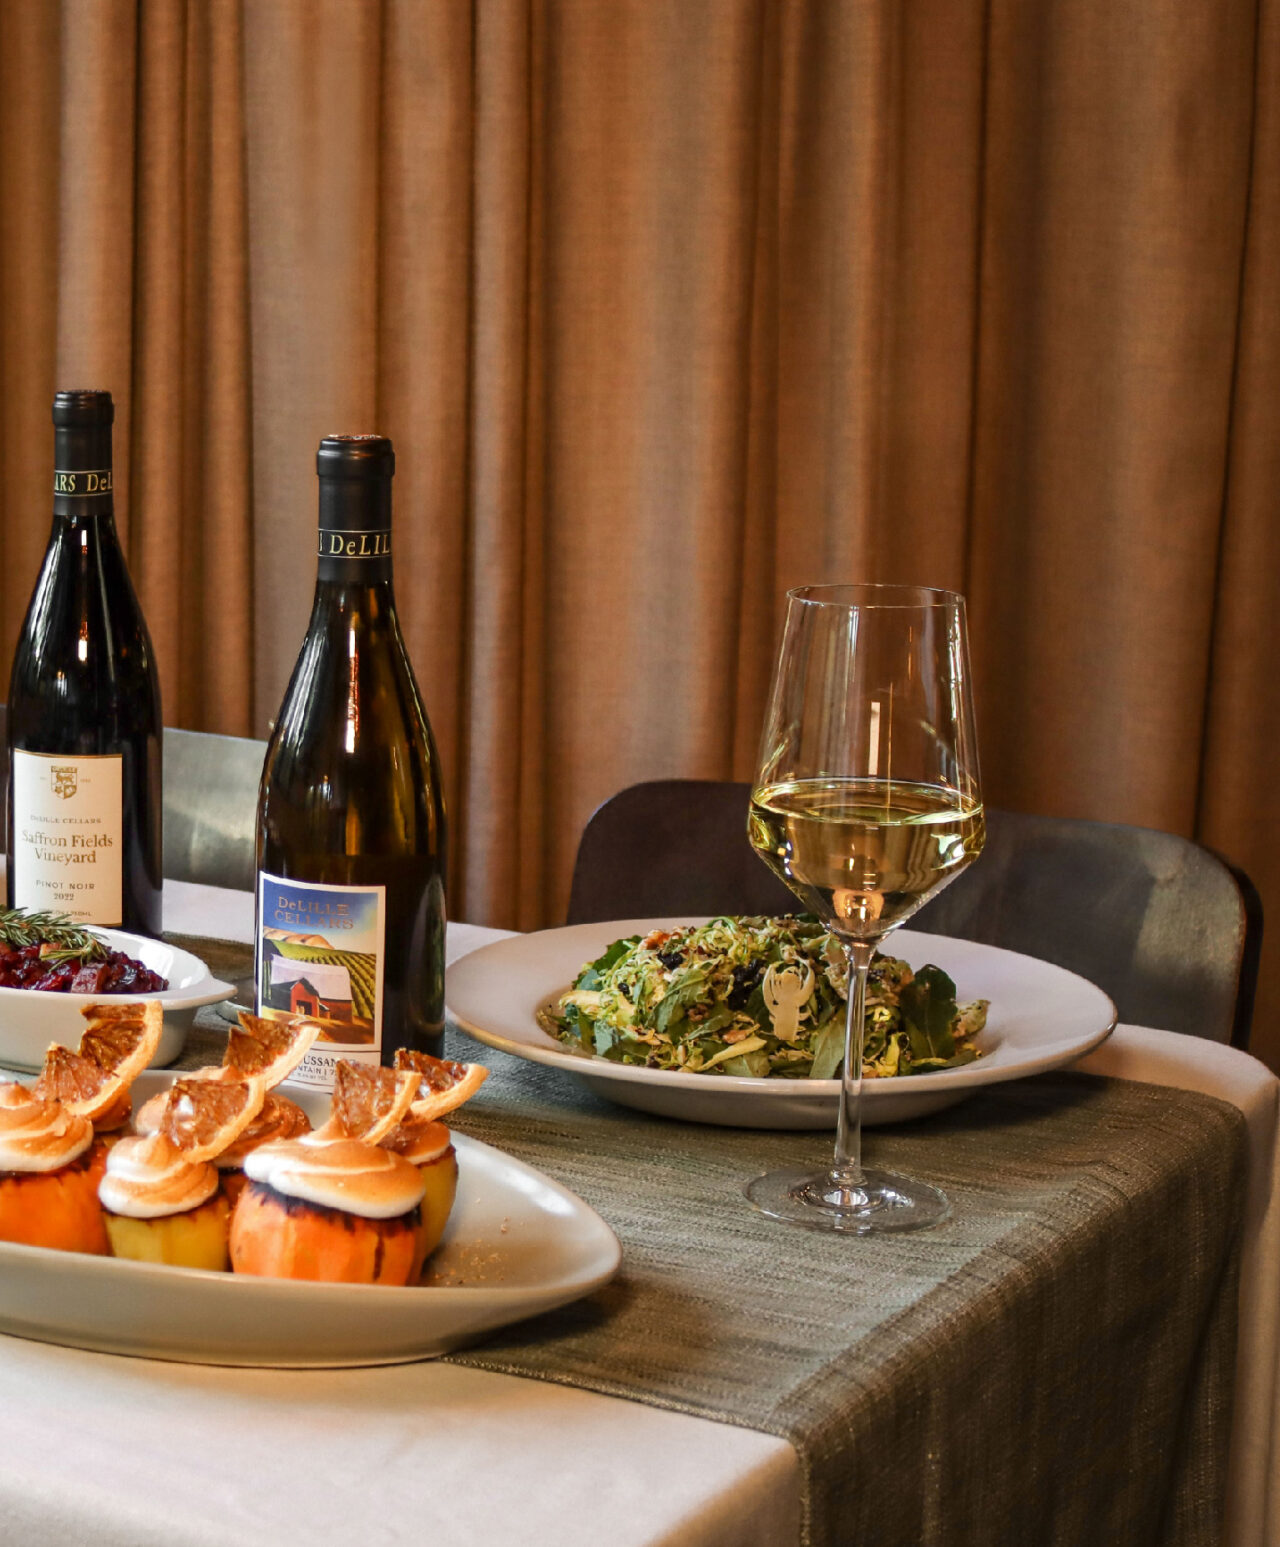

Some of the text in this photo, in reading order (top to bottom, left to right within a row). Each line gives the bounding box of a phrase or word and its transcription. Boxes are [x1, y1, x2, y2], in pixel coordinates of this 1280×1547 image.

[328, 534, 390, 556] DeLIL
[22, 829, 113, 848] Saffron Fields
[35, 847, 96, 866] Vineyard
[35, 879, 63, 889] PINOT
[53, 892, 75, 901] 2022
[278, 895, 351, 916] DeLILLE
[274, 909, 354, 929] CELLARS
